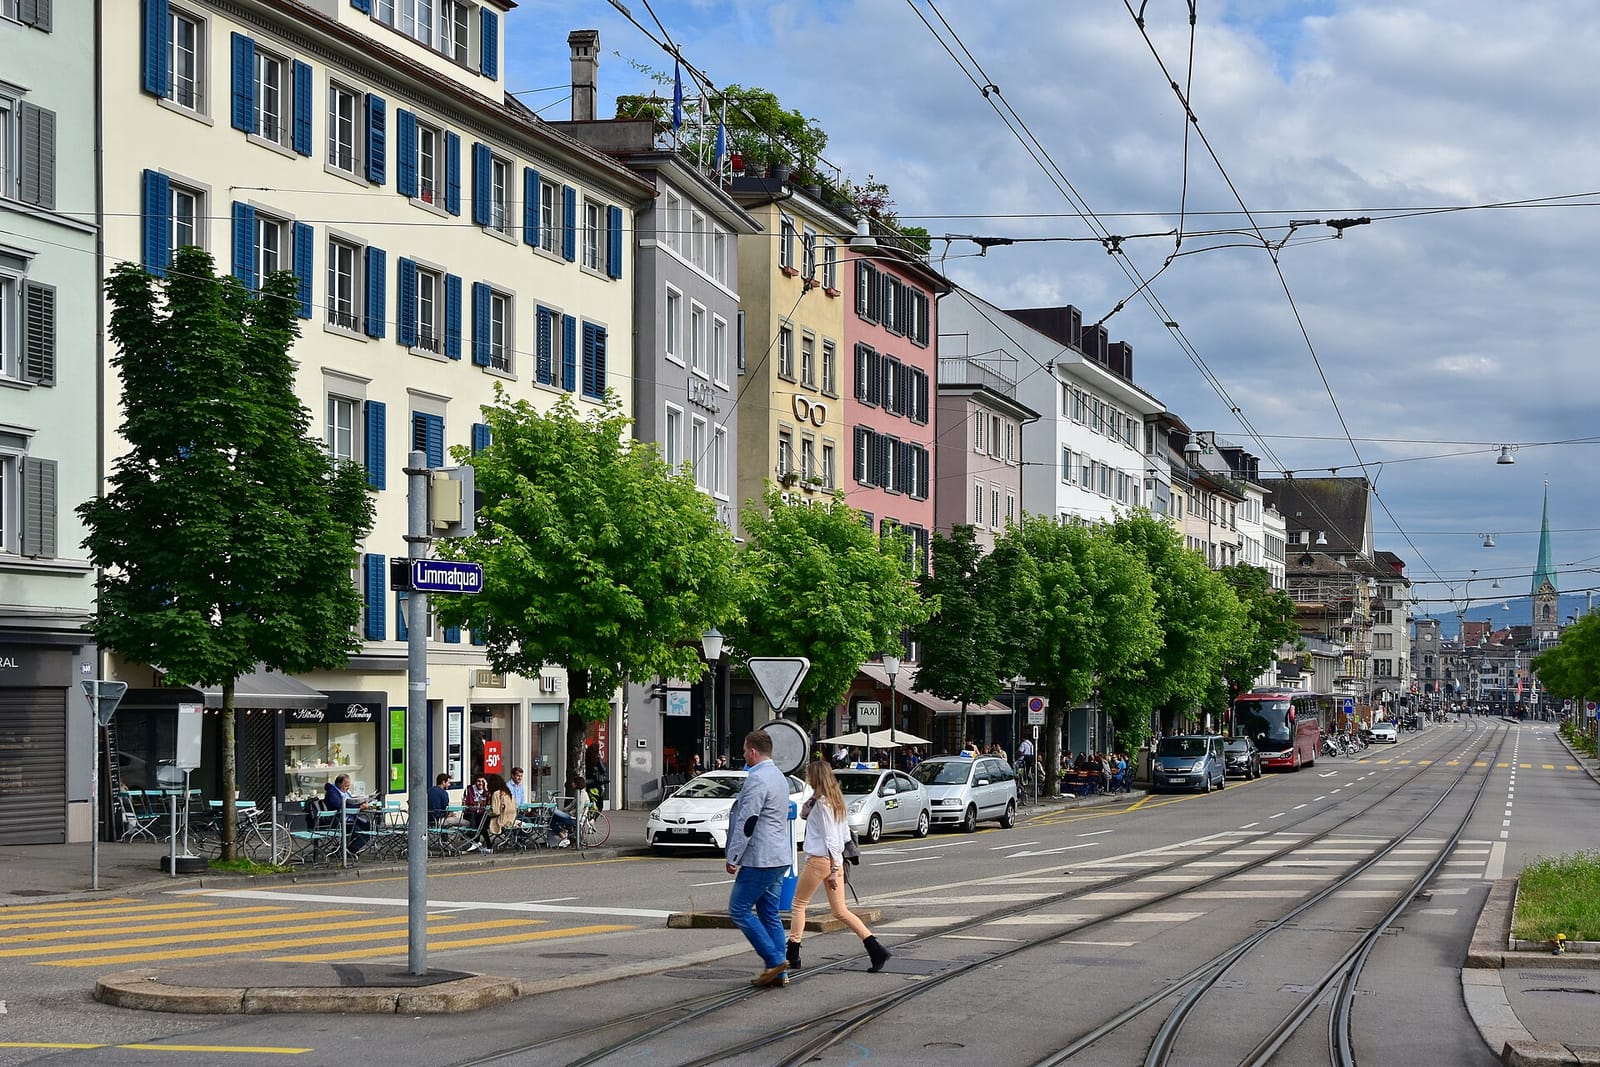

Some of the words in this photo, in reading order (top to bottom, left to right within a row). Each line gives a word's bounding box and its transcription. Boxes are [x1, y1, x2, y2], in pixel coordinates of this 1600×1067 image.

[417, 563, 479, 590] Limmatquai
[543, 676, 562, 692] WE
[859, 707, 878, 716] TAXI
